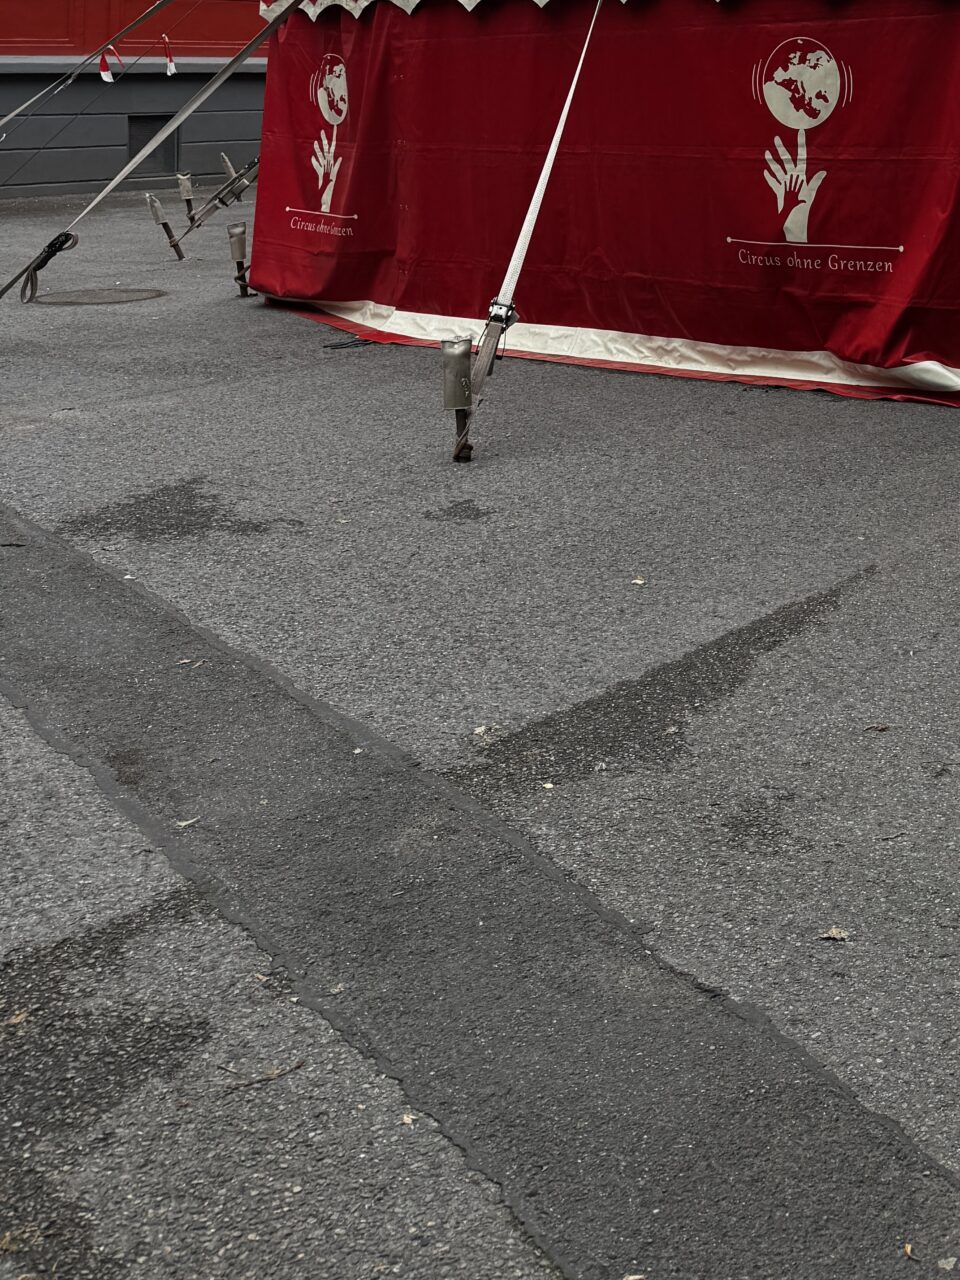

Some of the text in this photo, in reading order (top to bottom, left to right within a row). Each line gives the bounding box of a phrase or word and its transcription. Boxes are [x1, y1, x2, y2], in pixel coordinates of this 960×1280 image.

[290, 216, 316, 231] Circus
[330, 222, 354, 236] Gzen
[738, 248, 894, 273] Circus ohne Grenzen
